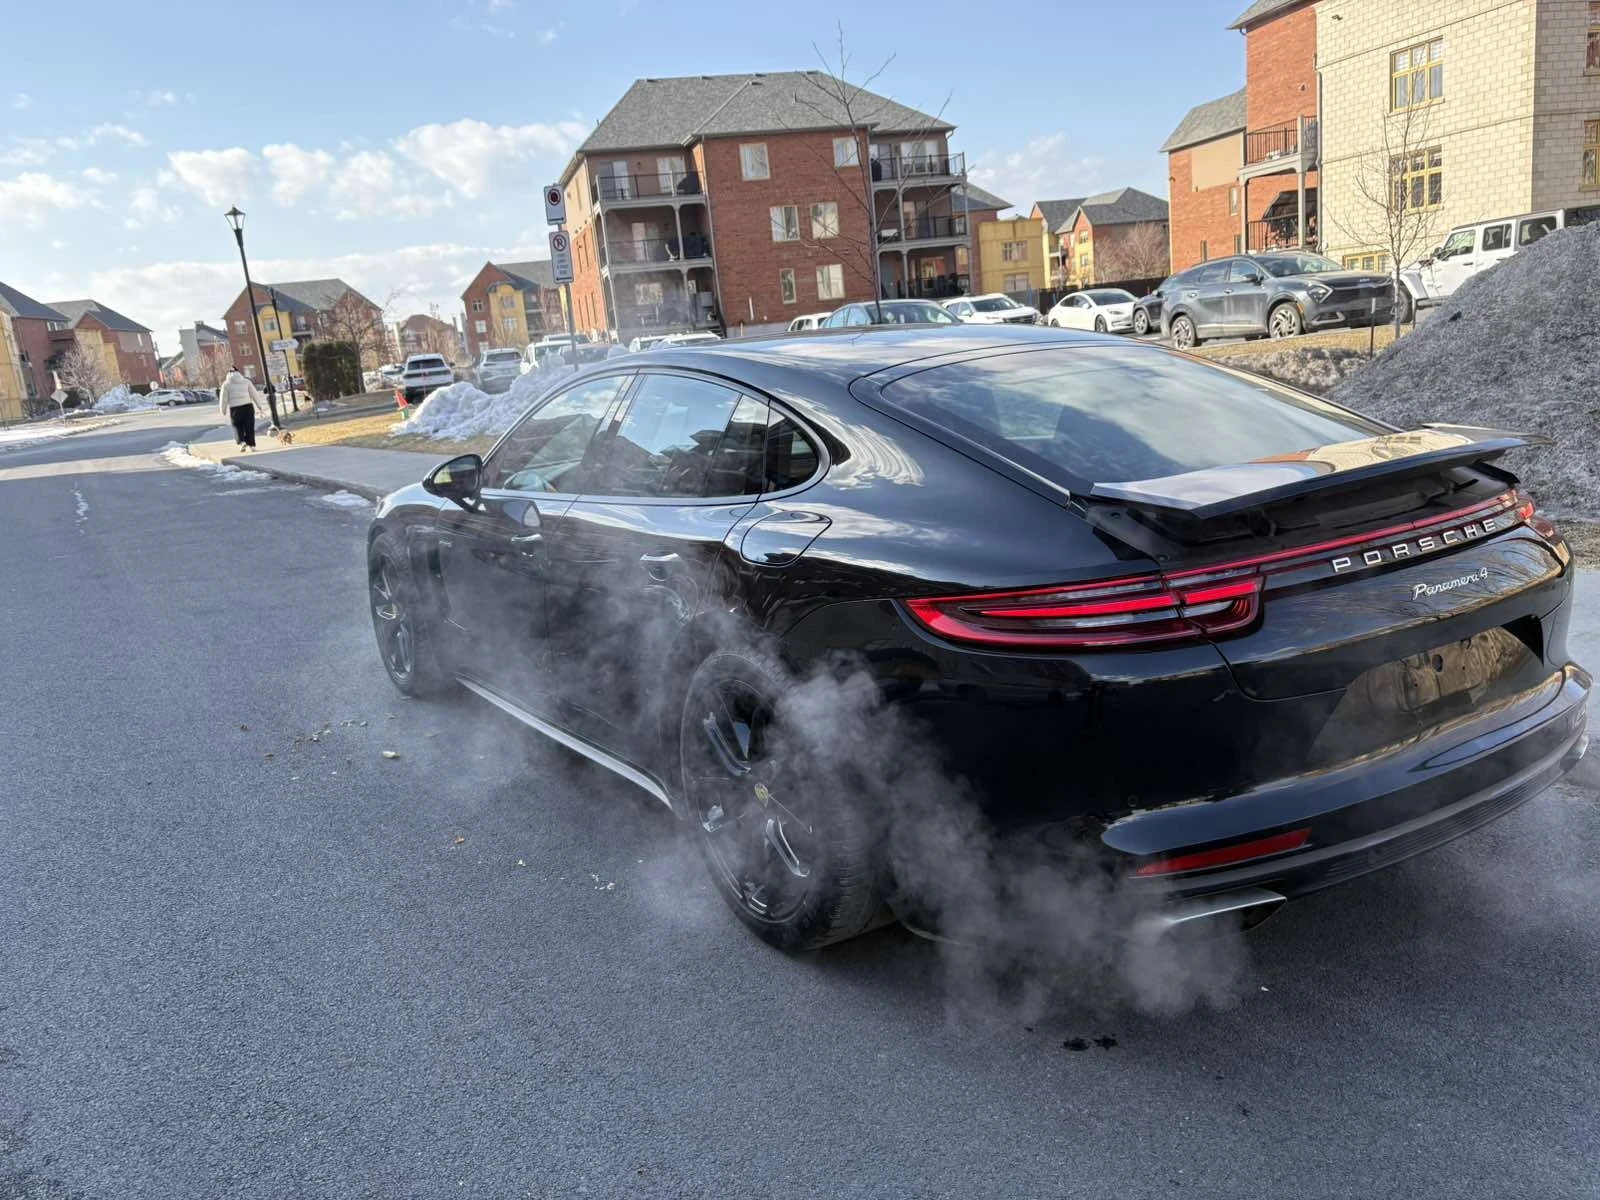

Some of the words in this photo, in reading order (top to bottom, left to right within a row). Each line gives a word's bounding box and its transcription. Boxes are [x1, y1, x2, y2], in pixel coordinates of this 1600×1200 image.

[1332, 518, 1497, 573] PORSCHE
[1412, 572, 1479, 601] Panamera
[1477, 567, 1489, 580] 4
